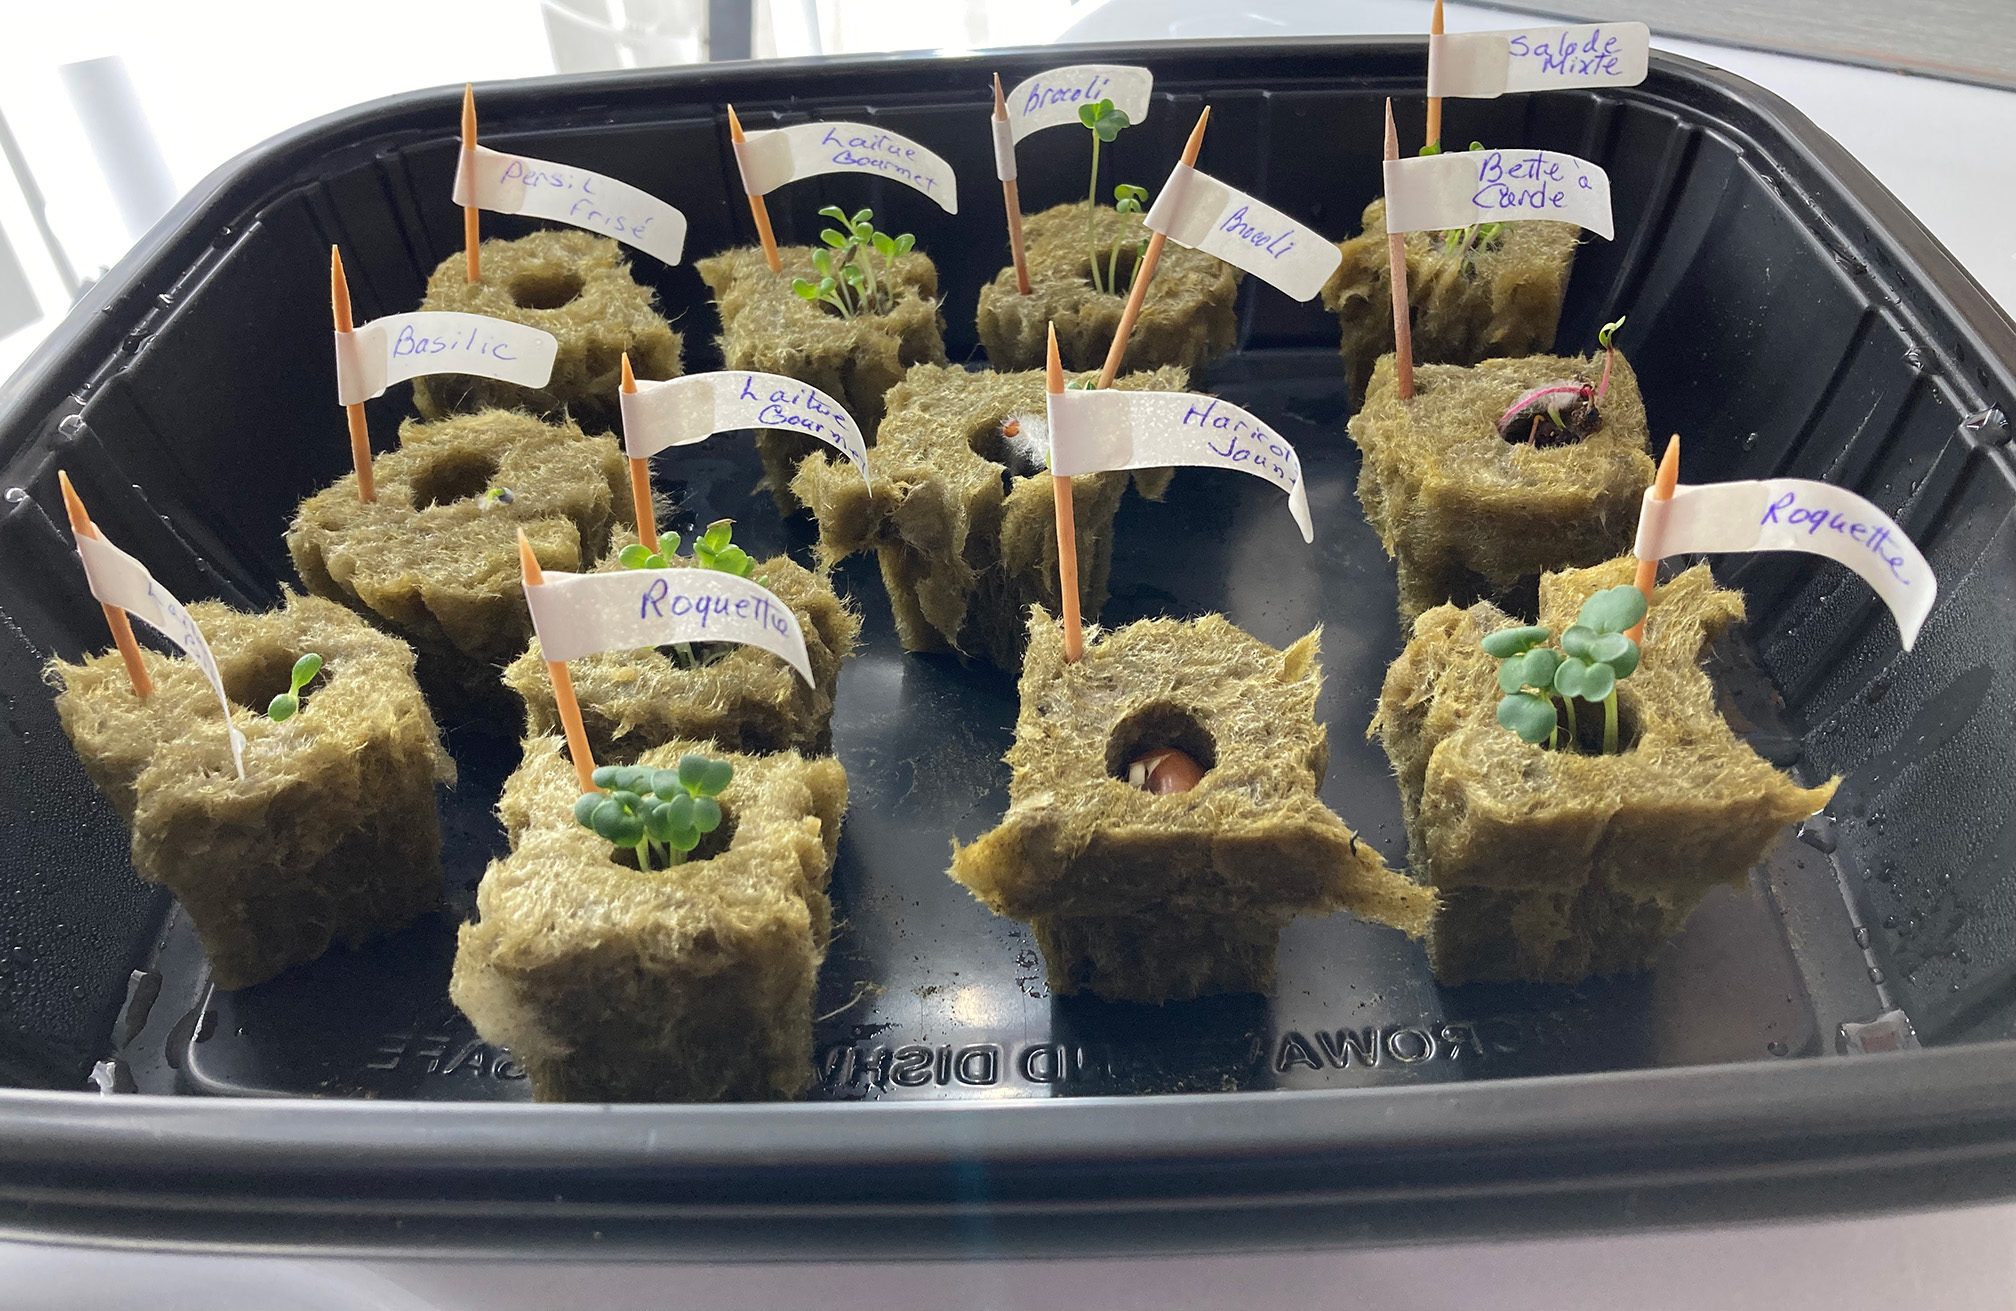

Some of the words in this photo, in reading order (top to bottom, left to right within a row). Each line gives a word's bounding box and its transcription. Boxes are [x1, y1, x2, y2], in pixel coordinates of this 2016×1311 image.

[1509, 28, 1623, 58] Salade
[1541, 52, 1623, 77] Mixte
[821, 127, 917, 162] Laitue
[1478, 151, 1565, 183] Bette
[392, 324, 518, 361] Basilic
[740, 375, 850, 432] Laitue
[1760, 491, 1911, 586] Roquette
[640, 577, 790, 639] Roquette
